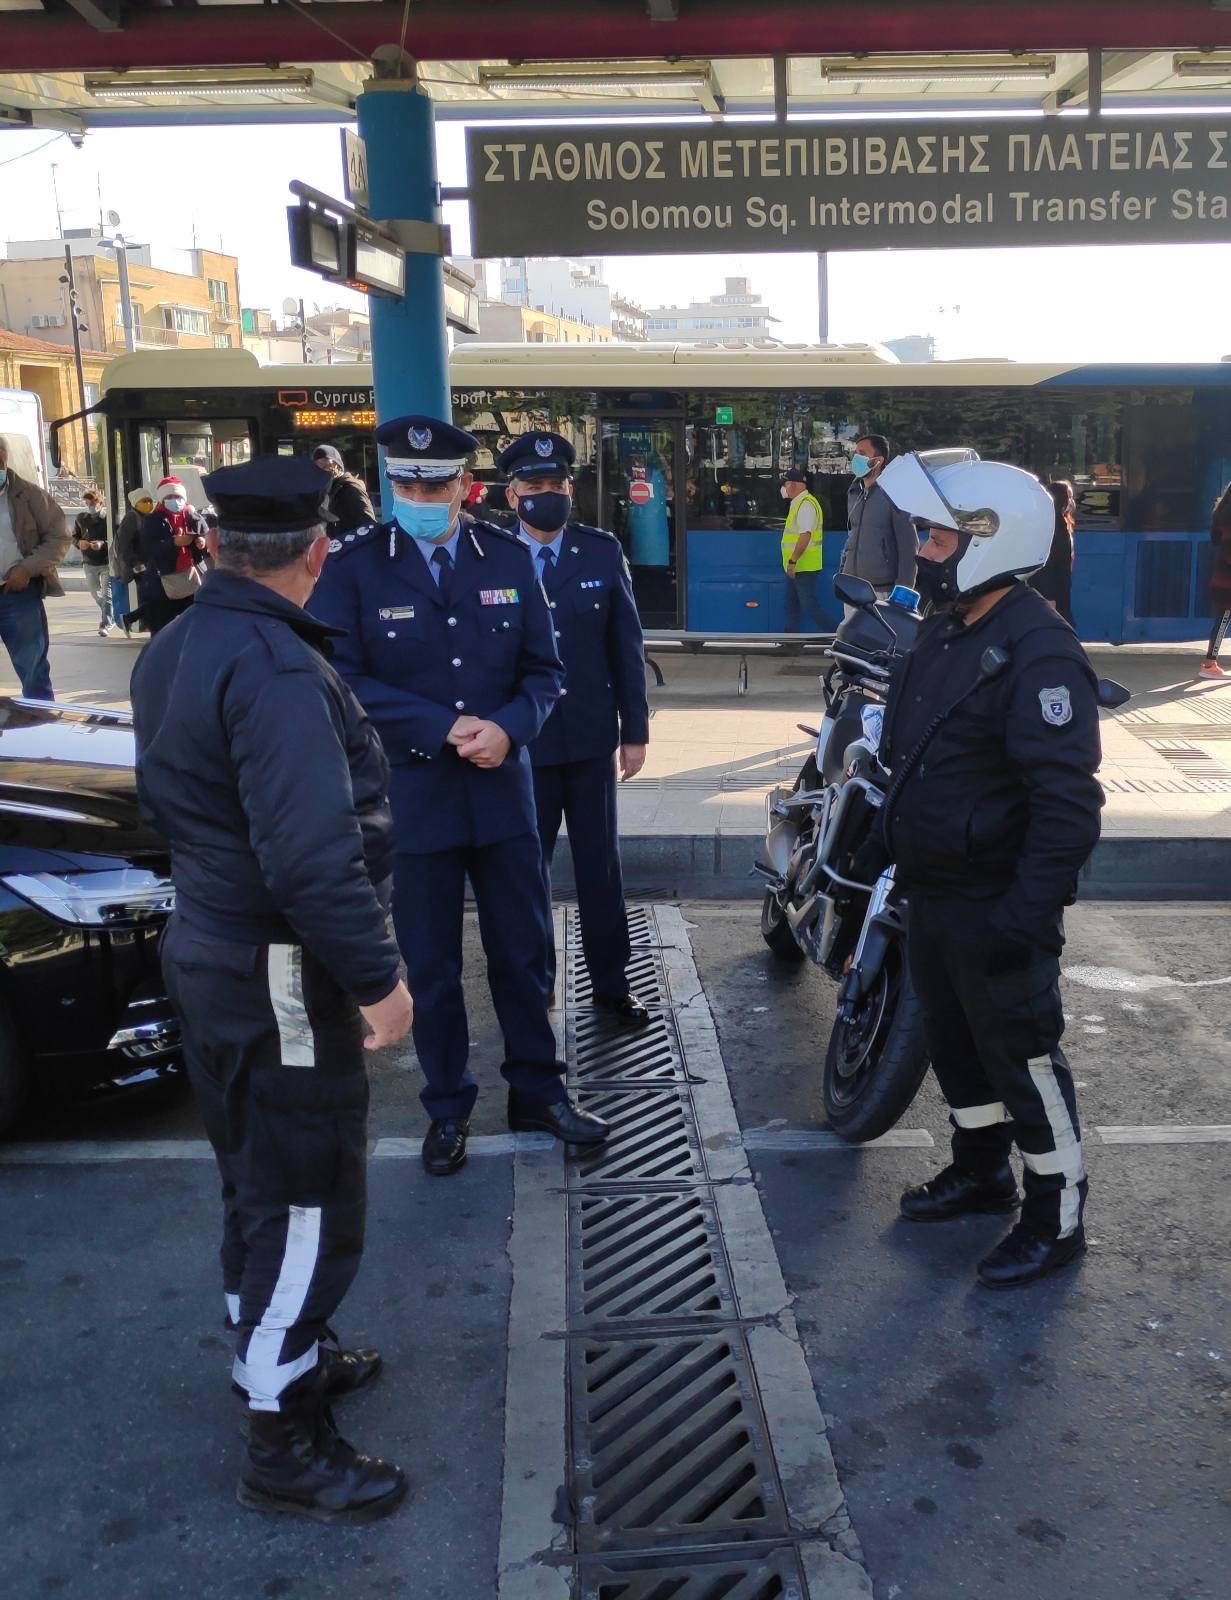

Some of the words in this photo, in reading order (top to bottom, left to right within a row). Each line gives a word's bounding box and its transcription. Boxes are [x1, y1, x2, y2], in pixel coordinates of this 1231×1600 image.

[483, 140, 666, 182] ΣΤΑΘΜΟΣ
[680, 135, 990, 179] ΜΕΤΕΠΙΒΙΒΑΣΗΣ
[1008, 131, 1193, 173] ΠΛΑΤΕΙΑΣ
[586, 199, 733, 231] Solomou
[746, 196, 797, 235] Sq.
[809, 193, 994, 226] Intermodal
[1008, 190, 1157, 223] Transfer
[314, 390, 366, 407] Cyprus
